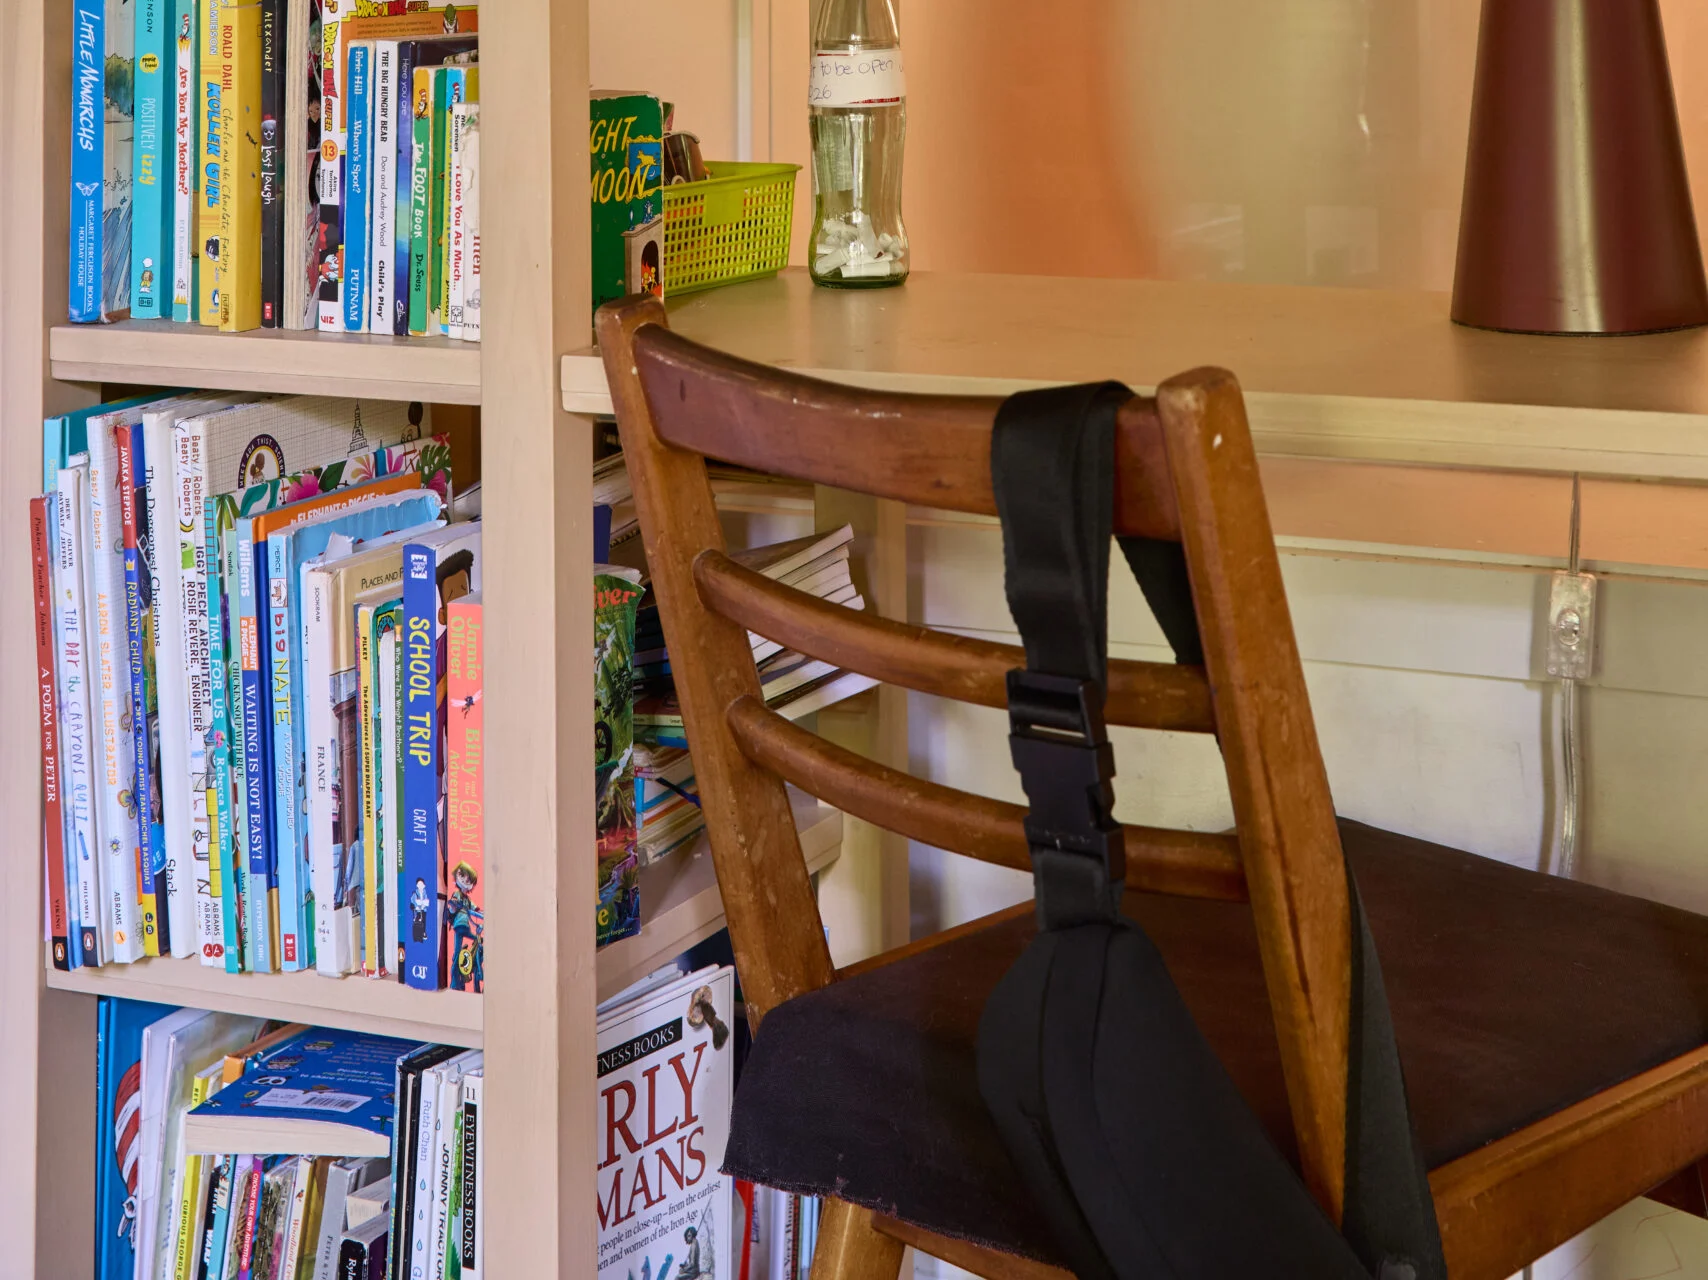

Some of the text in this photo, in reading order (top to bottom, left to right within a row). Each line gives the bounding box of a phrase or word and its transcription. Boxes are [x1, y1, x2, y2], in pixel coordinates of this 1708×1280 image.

[406, 0, 430, 12] SUPER
[222, 24, 233, 93] ROALD DAHL
[264, 11, 273, 73] Alexander
[820, 61, 831, 77] to
[834, 61, 854, 77] be
[77, 8, 101, 152] LITTLE MONARCHS
[380, 50, 389, 142] THE BIG HUNGRY BEAR
[400, 58, 410, 116] Here you are
[141, 97, 156, 153] POSITIVELY
[176, 65, 188, 196] Are You My Mother?
[324, 98, 333, 132] SUPER
[352, 50, 364, 194] Eric Hill Where's Spot?
[591, 116, 638, 155] GHT
[323, 144, 335, 157] 13
[261, 170, 276, 205] Laugh
[378, 191, 387, 221] Audrey
[380, 174, 388, 190] and
[413, 167, 427, 205] FOOT
[77, 226, 85, 287] HOLIDAY HOUSE
[86, 200, 95, 313] MARGARET FERGUSON BOOKS
[379, 222, 387, 247] Wood
[453, 205, 463, 291] You As Much...
[349, 269, 360, 322] PUTNAM
[377, 260, 385, 293] Child's
[414, 268, 424, 293] Seuss
[119, 446, 132, 527] JAVAKA STEPTOE
[180, 436, 192, 517] Beaty Roberts
[191, 435, 203, 515] Beaty Roberts
[90, 469, 102, 550] Beaty Roberts
[237, 539, 252, 597] Willems
[361, 574, 384, 589] PLACES
[384, 571, 398, 583] AND
[97, 593, 109, 636] AARON
[126, 581, 138, 636] RADIANT
[195, 546, 211, 707] IGGY ARCHITECT
[186, 581, 202, 733] ROSIE ENGINEER
[208, 614, 224, 720] TIME FOR US
[241, 628, 250, 657] PIGGIE
[249, 624, 258, 670] ELEPHANT
[273, 613, 291, 726] big NATE
[451, 615, 464, 680] Oliver
[467, 616, 482, 681] Jamie
[64, 609, 88, 822] THE DAY CRAYONS QUIT
[232, 661, 245, 779] CHICKEN SOUP WITH RICE
[409, 616, 432, 767] SCHOOL TRIP
[41, 667, 57, 803] A POEM PETER
[136, 736, 144, 766] YOUNG
[464, 727, 480, 779] Billy
[244, 684, 262, 861] WAITING IS NOT EASY!
[317, 745, 326, 793] FRANCE
[449, 749, 461, 830] Adventure
[140, 793, 148, 845] JEAN-MICHEL
[216, 756, 229, 852] Rebecca Walker
[413, 808, 427, 845] CRAFT
[142, 847, 150, 886] BASQUIAT
[165, 858, 176, 898] Stack
[113, 891, 122, 926] ABRAMS
[212, 902, 221, 936] ABRAMS
[633, 1025, 675, 1057] BOOKS
[420, 1100, 432, 1161] Ruth Chan
[597, 1041, 708, 1170] RLY
[438, 1143, 450, 1206] JOHNNY
[463, 1113, 477, 1259] EYEWITNESS BOOKS
[176, 1199, 189, 1273] CURIOUS GEORGE
[241, 1172, 259, 1268] CHOOSE ADVENTURE
[600, 1180, 721, 1256] people in close-up from the earliest
[609, 1208, 699, 1265] and women of the Iron Age
